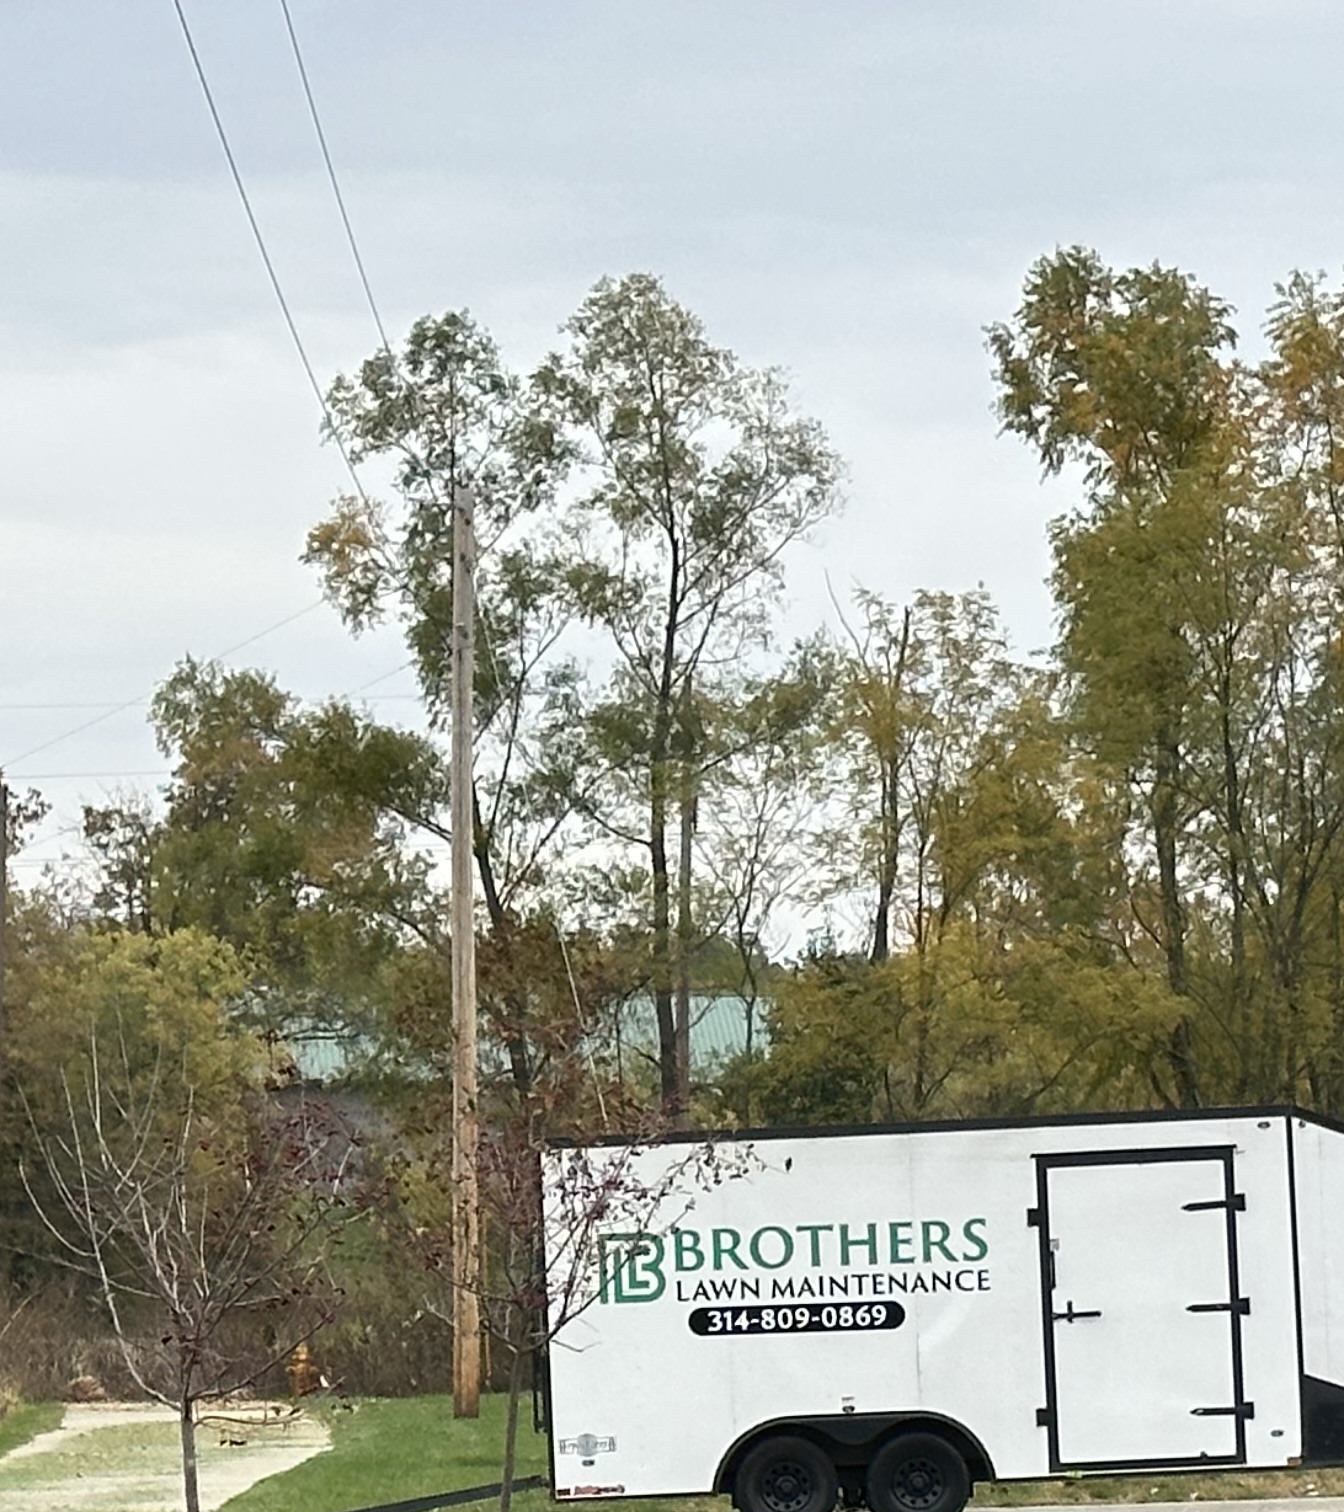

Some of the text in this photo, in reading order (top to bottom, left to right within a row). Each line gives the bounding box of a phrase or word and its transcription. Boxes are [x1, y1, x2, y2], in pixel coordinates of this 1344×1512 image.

[673, 1217, 990, 1272] BROTHERS
[676, 1268, 992, 1302] LAWN MAINTENANCE
[707, 1304, 888, 1332] 314-809-0869
